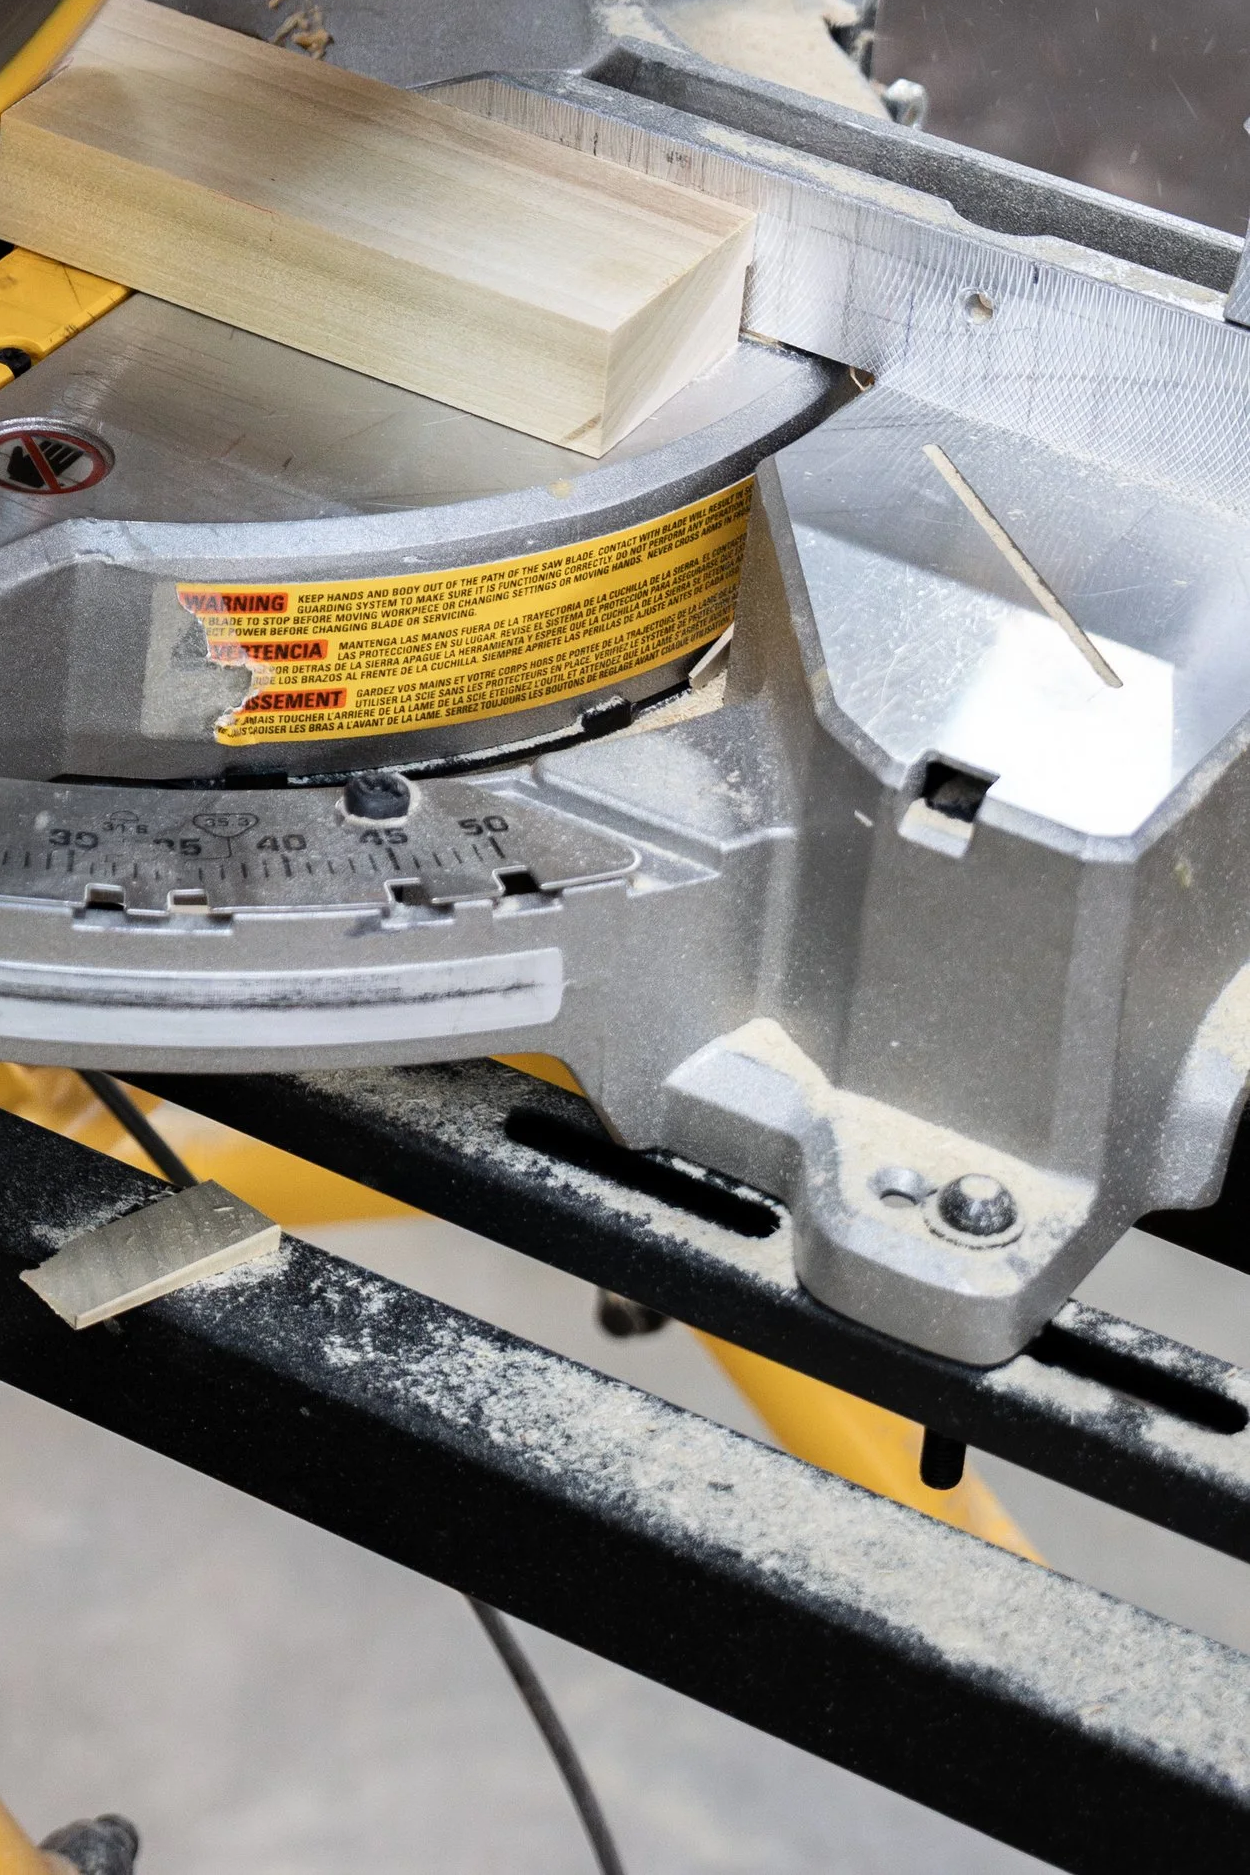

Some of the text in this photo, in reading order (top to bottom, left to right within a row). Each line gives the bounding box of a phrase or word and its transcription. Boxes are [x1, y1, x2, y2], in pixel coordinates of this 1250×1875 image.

[292, 615, 331, 624] BEFORE
[335, 611, 377, 621] MOVING
[380, 604, 438, 618] WORKPIECE
[442, 601, 454, 610] OR
[458, 591, 509, 608] CHANGING
[512, 580, 556, 597] SETTINGS
[559, 577, 571, 586] OR
[574, 566, 608, 583] MOVING
[297, 603, 351, 613] GUARDING
[356, 599, 396, 609] SYSTEM
[401, 597, 412, 605] TO
[416, 592, 444, 603] MAKE
[447, 588, 472, 599] SURE
[475, 586, 483, 594] IT
[486, 584, 495, 592] IS
[498, 569, 561, 590] FUNCTIONING
[298, 594, 323, 602] KEEP
[326, 591, 362, 601] HANDS
[366, 589, 388, 598] AND
[392, 586, 419, 596] BODY
[423, 582, 442, 592] OUT
[445, 580, 457, 589] OF
[460, 577, 477, 587] THE
[480, 572, 504, 583] PATH
[508, 569, 519, 578] OF
[522, 565, 538, 575] THE
[541, 559, 562, 571] SAW
[184, 595, 284, 611] WARNING
[270, 627, 308, 635] BEFORE
[312, 623, 367, 633] CHANGING
[370, 619, 402, 629] BLADE
[406, 617, 419, 625] OR
[292, 664, 331, 673] DETRAS
[334, 663, 346, 671] DE
[365, 658, 399, 668] SIERRA
[402, 652, 440, 664] APAGUE
[444, 650, 455, 658] LA
[458, 636, 524, 656] HERRAMIENTA
[535, 626, 566, 640] ESPERE
[569, 620, 585, 631] QUE
[338, 638, 397, 650] MANTENGA
[400, 635, 418, 644] LAS
[421, 629, 458, 641] MANOS
[461, 623, 490, 635] FUERA
[493, 620, 505, 629] DE
[508, 617, 518, 626] LA
[338, 652, 356, 660] LAS
[359, 643, 431, 658] PROTECCIONES
[434, 641, 447, 649] EN
[450, 638, 462, 647] SU
[500, 624, 530, 638] REVISE
[534, 622, 543, 630] EL
[545, 611, 582, 627] SISTEMA
[301, 674, 341, 683] BRAZOS
[360, 668, 397, 679] FRENTE
[400, 666, 412, 675] DE
[416, 664, 427, 673] LA
[481, 647, 522, 662] SIEMPRE
[524, 637, 561, 653] APRIETE
[564, 631, 580, 643] LAS
[356, 643, 599, 697] GARDEZ VOS MAINS ET VOTRE CORPS HORS DE PORTEE
[278, 713, 324, 722] TOUCHER
[378, 707, 390, 715] DE
[408, 701, 434, 711] LAME
[438, 699, 449, 707] DE
[453, 696, 463, 705] LA
[466, 692, 486, 702] SCIE
[490, 682, 531, 697] ETEIGNEZ
[567, 669, 576, 678] ET
[308, 723, 333, 731] BRAS
[401, 715, 412, 723] LA
[444, 704, 477, 716] SERREZ
[481, 693, 525, 709] TOUJOURS
[528, 689, 542, 699] LES
[545, 677, 584, 694] BOUTONS
[356, 696, 397, 707] UTILISER
[415, 691, 435, 700] SCIE
[438, 686, 464, 697] SANS
[467, 683, 482, 692] LES
[485, 668, 547, 688] PROTECTEURS
[550, 664, 561, 673] EN
[49, 828, 100, 850] 30
[102, 820, 148, 834] 316
[256, 833, 308, 852] 40
[359, 827, 409, 846] 45
[457, 815, 510, 836] 50
